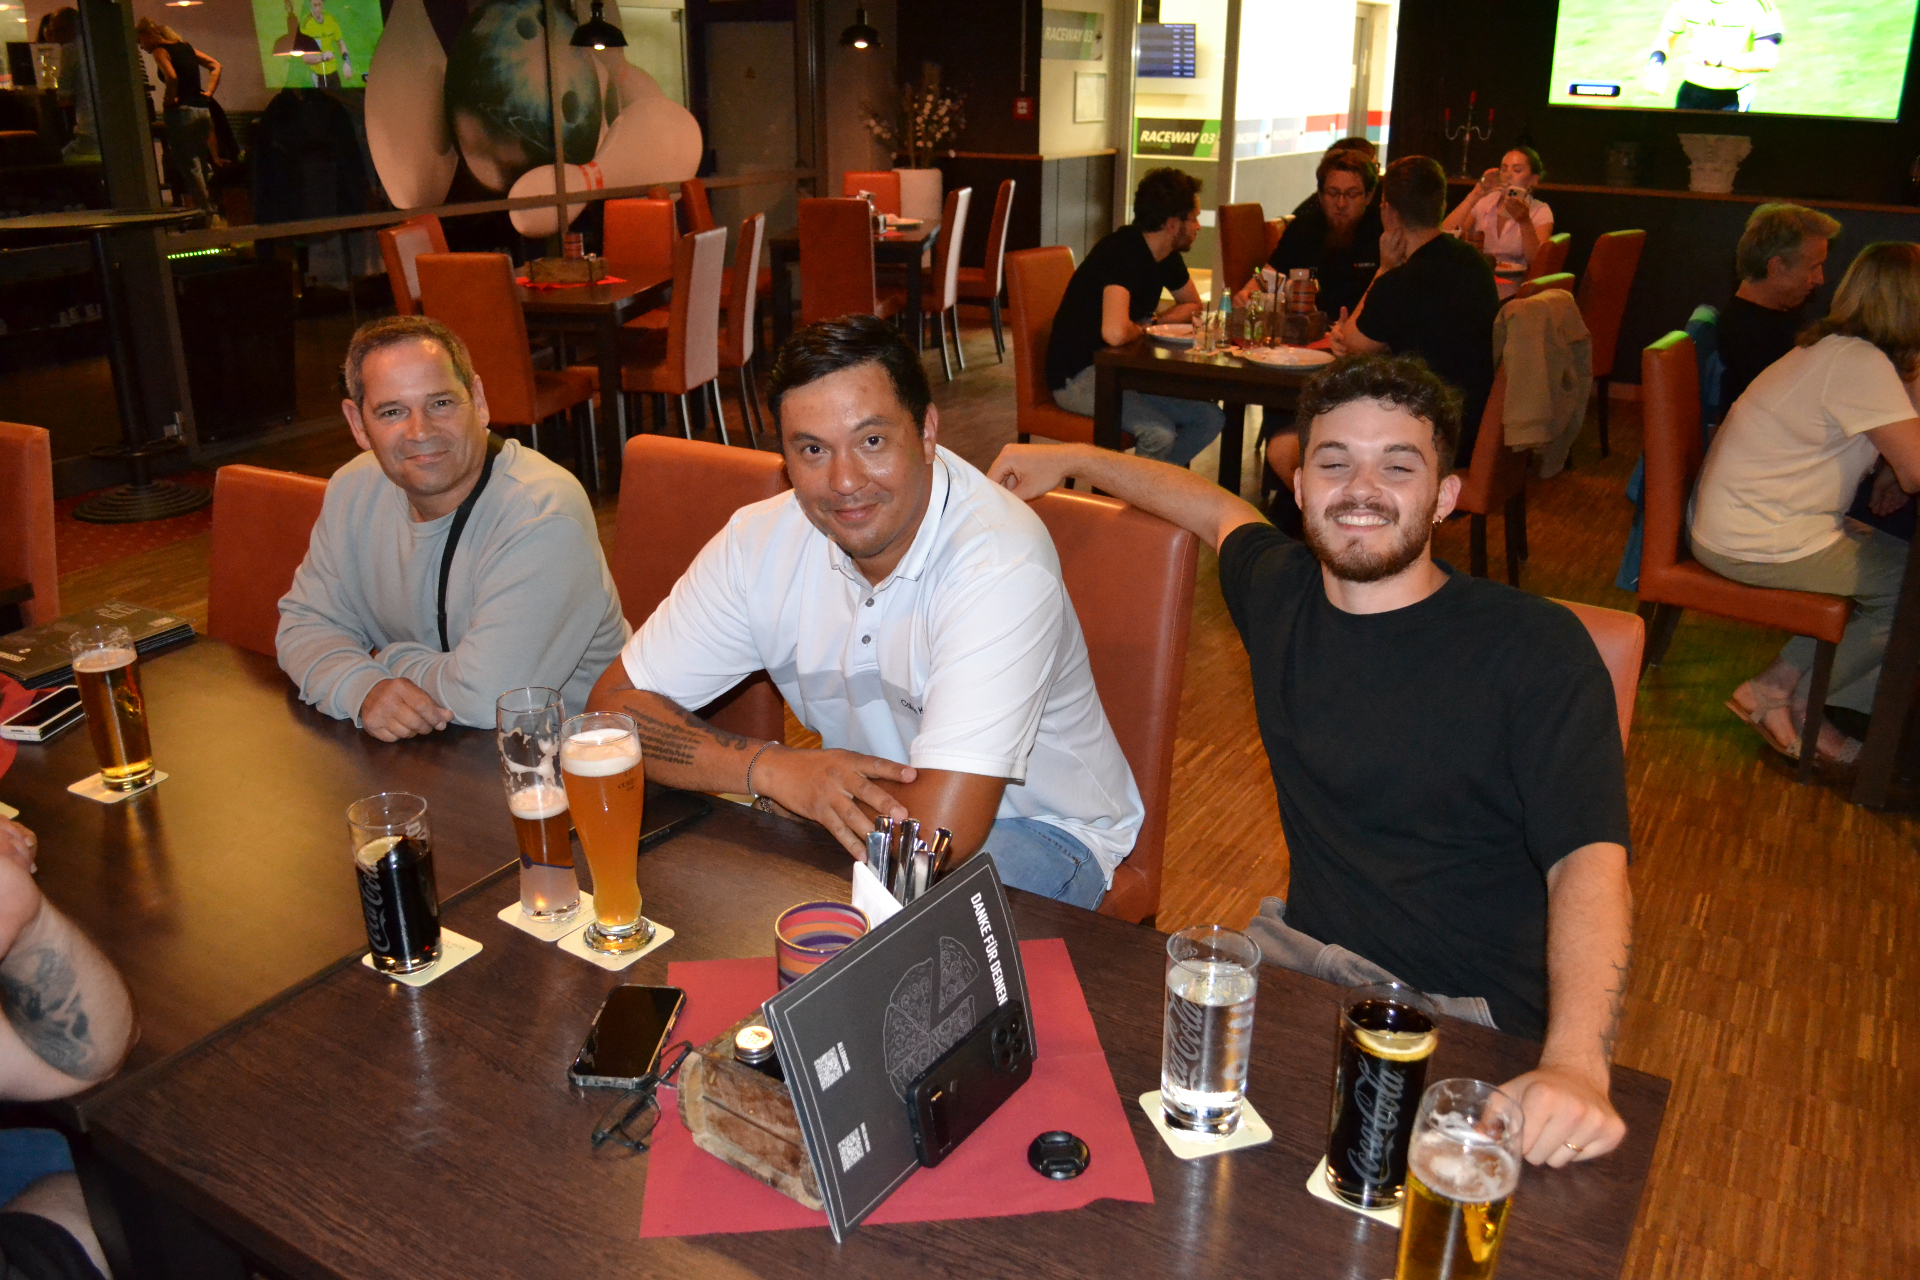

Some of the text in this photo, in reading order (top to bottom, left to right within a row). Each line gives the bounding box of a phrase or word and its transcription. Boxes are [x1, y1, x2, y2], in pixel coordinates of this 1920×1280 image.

[1044, 26, 1094, 43] RACEWAY 03
[1140, 130, 1216, 145] RACEWAY 03
[970, 891, 1009, 1007] DANKE FÜR DEINEN
